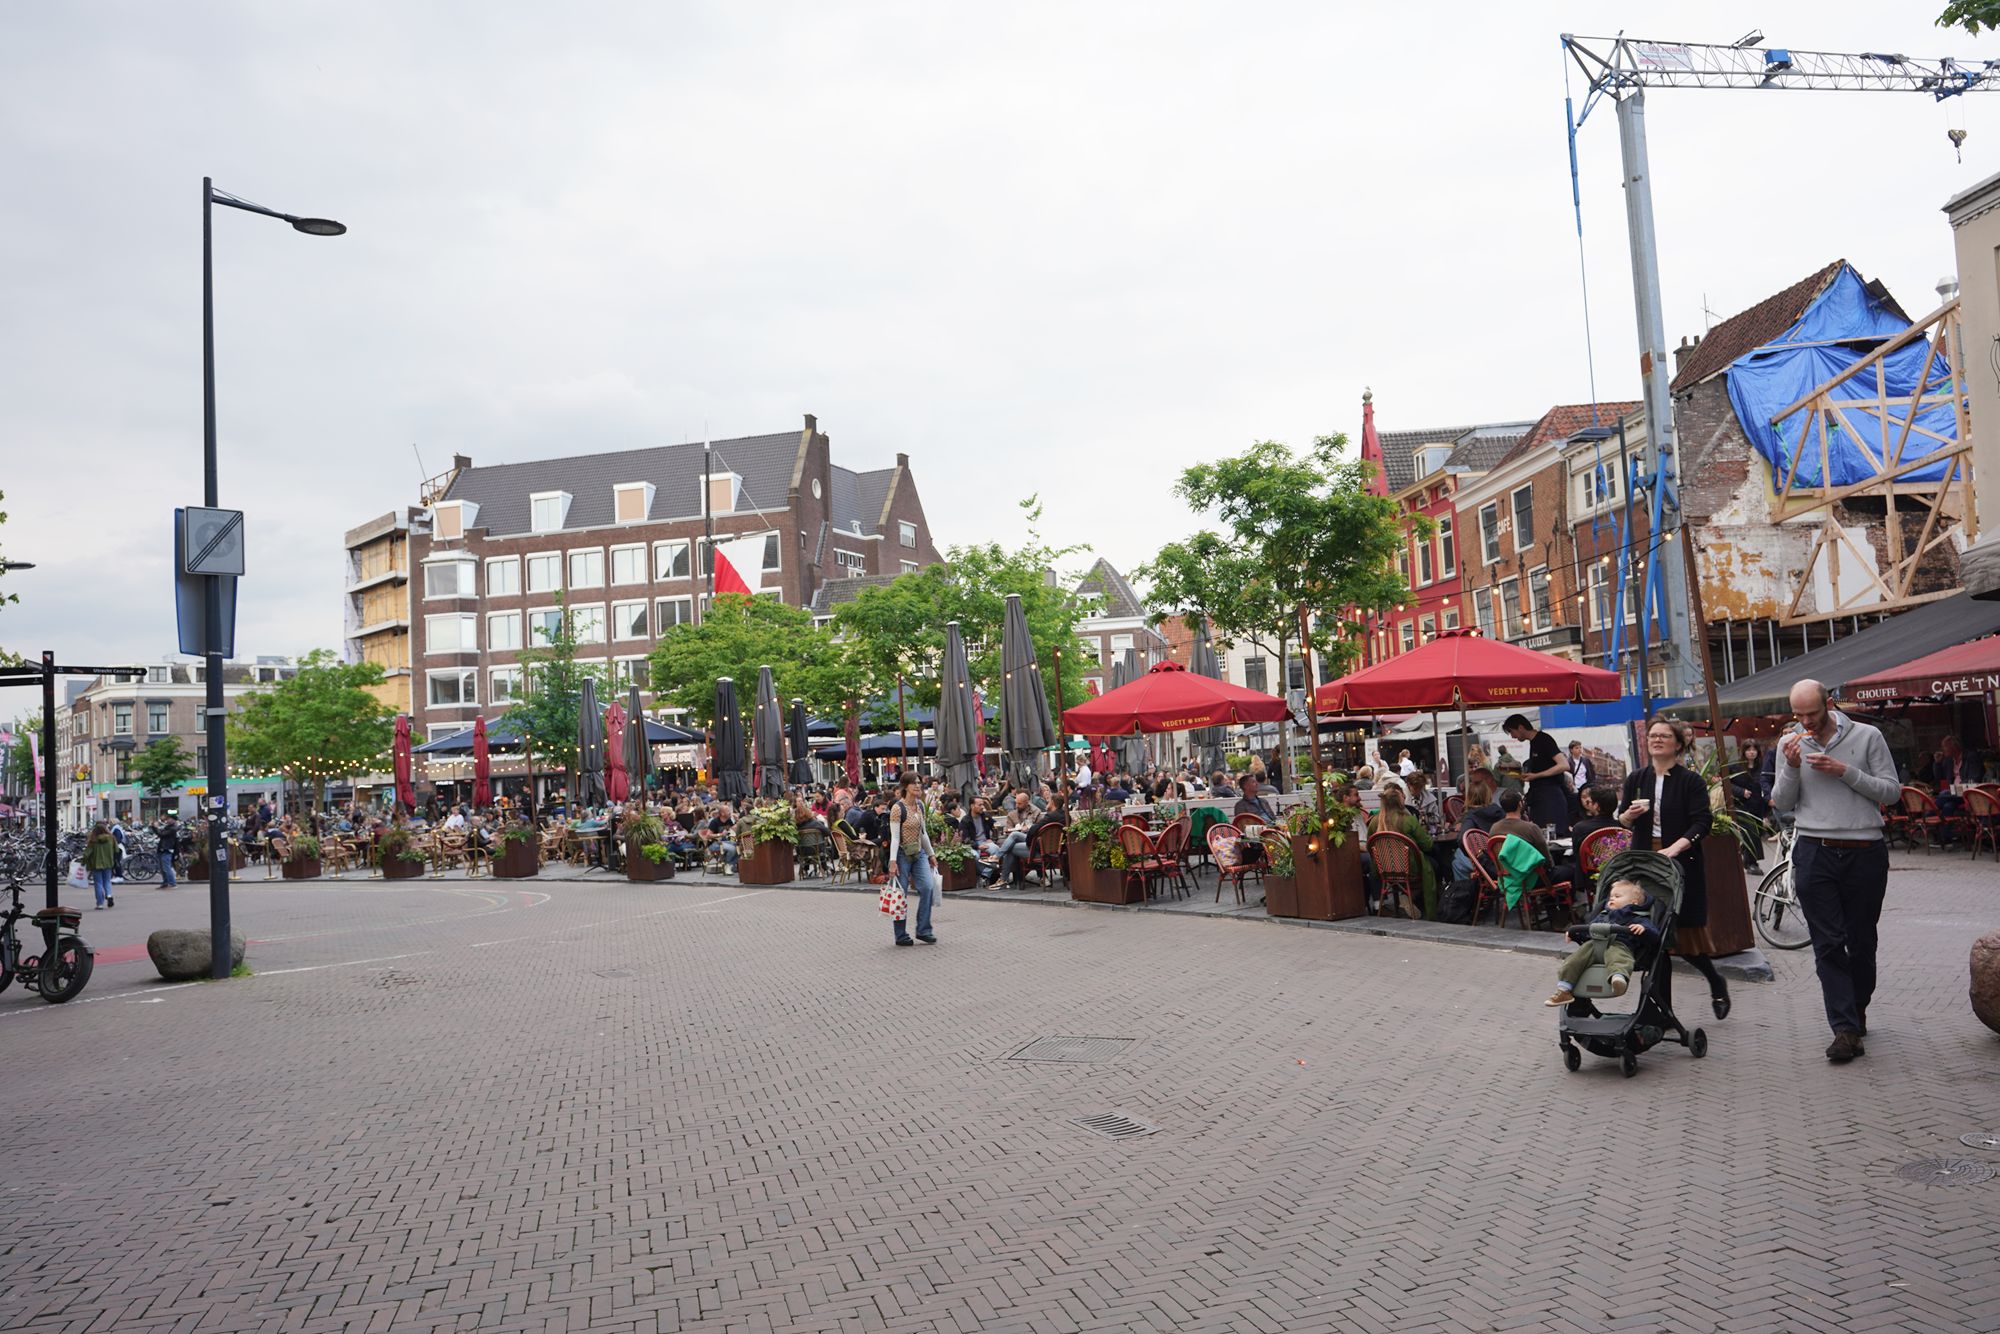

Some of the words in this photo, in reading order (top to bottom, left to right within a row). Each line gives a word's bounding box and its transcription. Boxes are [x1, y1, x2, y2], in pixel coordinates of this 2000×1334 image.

[1931, 677, 1969, 694] CAFÉ
[1487, 687, 1518, 696] VEDETT
[1856, 687, 1898, 699] CHOUFFE
[1161, 719, 1186, 727] VEDETT
